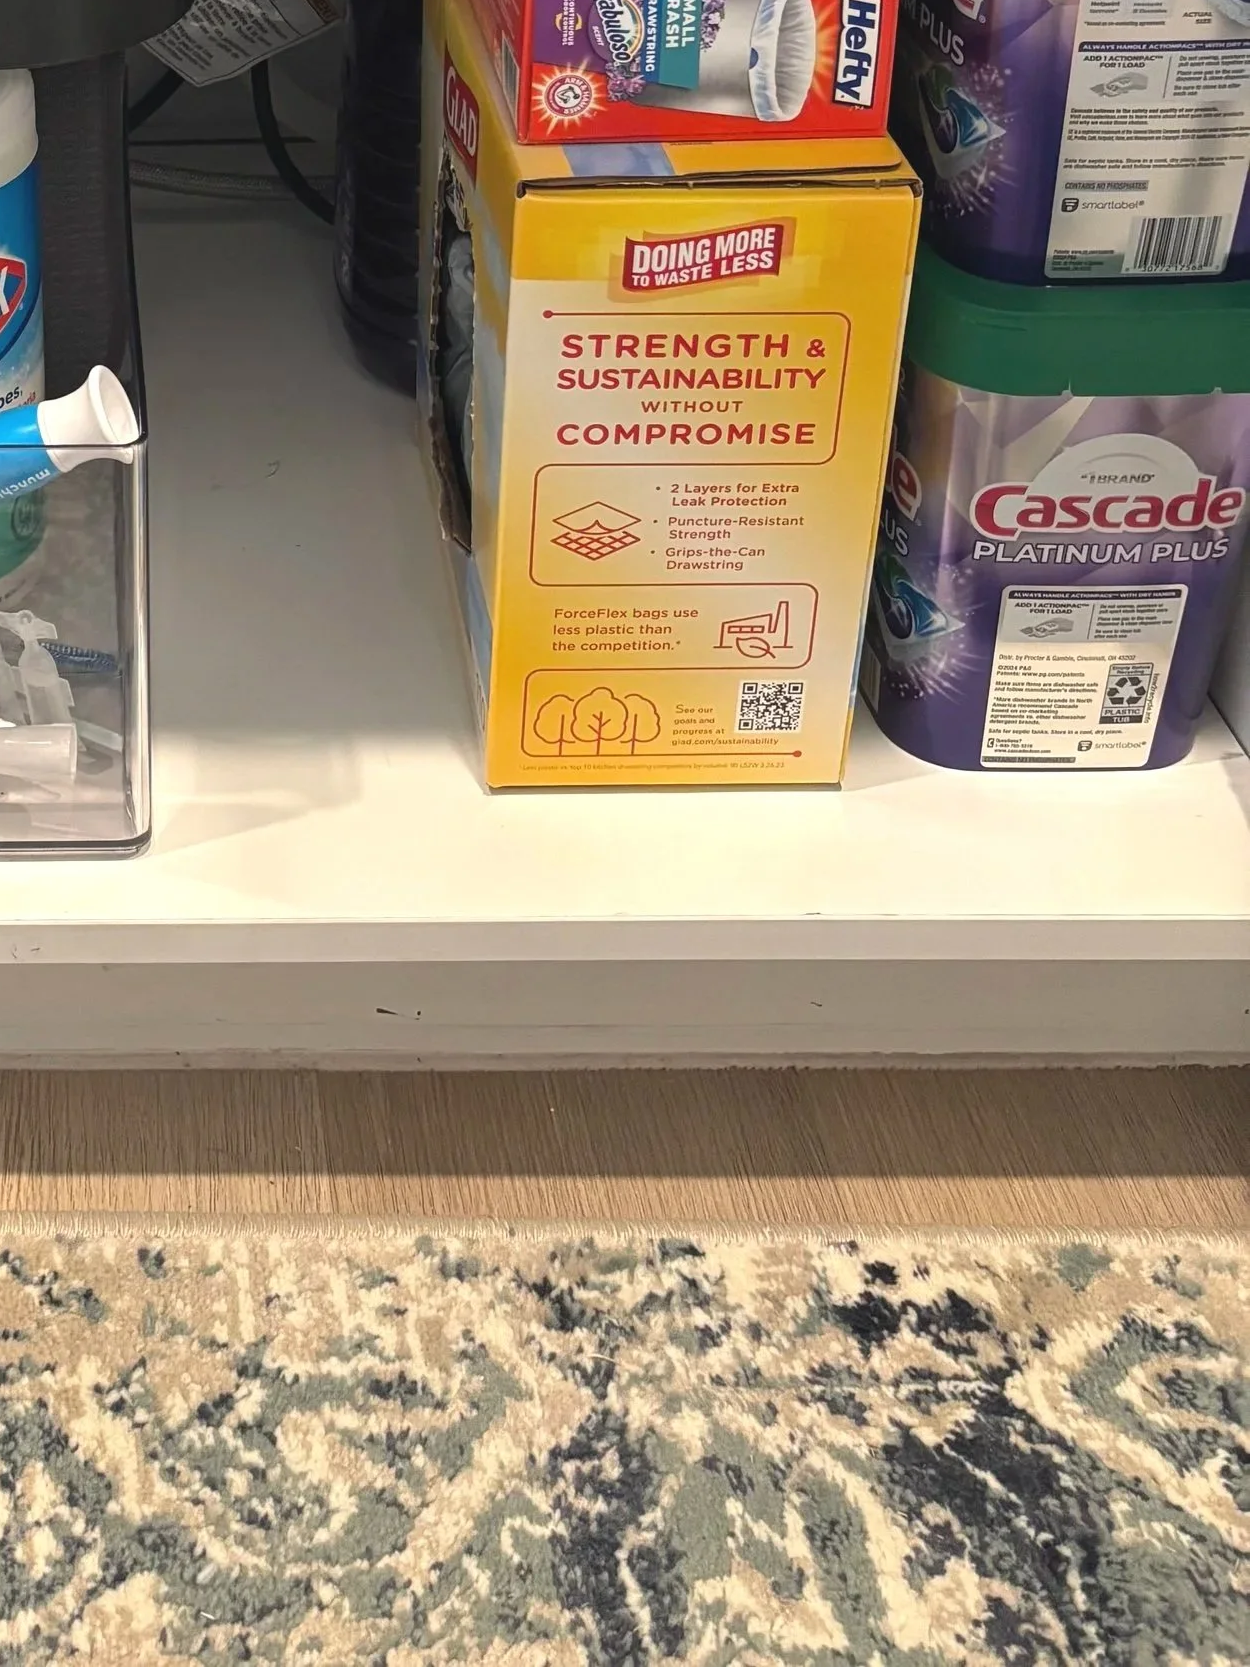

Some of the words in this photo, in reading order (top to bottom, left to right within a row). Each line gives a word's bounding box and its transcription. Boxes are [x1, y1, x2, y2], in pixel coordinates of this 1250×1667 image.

[592, 25, 604, 46] SCENT
[919, 7, 964, 65] PLUS
[844, 0, 877, 101] Hefty
[565, 77, 583, 86] ARM
[563, 89, 590, 114] HAMMER
[446, 66, 477, 157] GLAD
[632, 238, 711, 273] DOING
[715, 228, 776, 259] MORE
[632, 275, 650, 287] TO
[655, 263, 712, 286] WASTE
[720, 251, 774, 275] LESS
[561, 333, 789, 358] STRENGTH
[806, 338, 826, 358] &
[557, 368, 826, 390] SUSTAINABILITY
[640, 400, 744, 413] WITHOUT
[556, 423, 816, 445] COMPROMISE
[671, 484, 680, 493] 2
[684, 483, 732, 496] Layers
[736, 483, 756, 493] for
[761, 483, 800, 493] Extra
[672, 496, 706, 507] Leak
[711, 496, 787, 507] Protection
[974, 477, 1242, 537] Cascade
[668, 516, 805, 527] Puncture-Resistant
[669, 529, 731, 541] Strength
[665, 547, 765, 559] Grips-the-Can
[972, 541, 1143, 564] PLATINUM
[1151, 538, 1230, 563] PLUS
[666, 560, 744, 572] Drawstring
[554, 608, 628, 619] ForceFlex
[632, 607, 669, 621] bags
[673, 608, 699, 619] use
[552, 625, 575, 634] less
[579, 624, 635, 637] plastic
[639, 624, 672, 634] than
[552, 640, 576, 651] the
[676, 704, 696, 714] See
[674, 717, 696, 725] goals
[672, 728, 712, 737] progress
